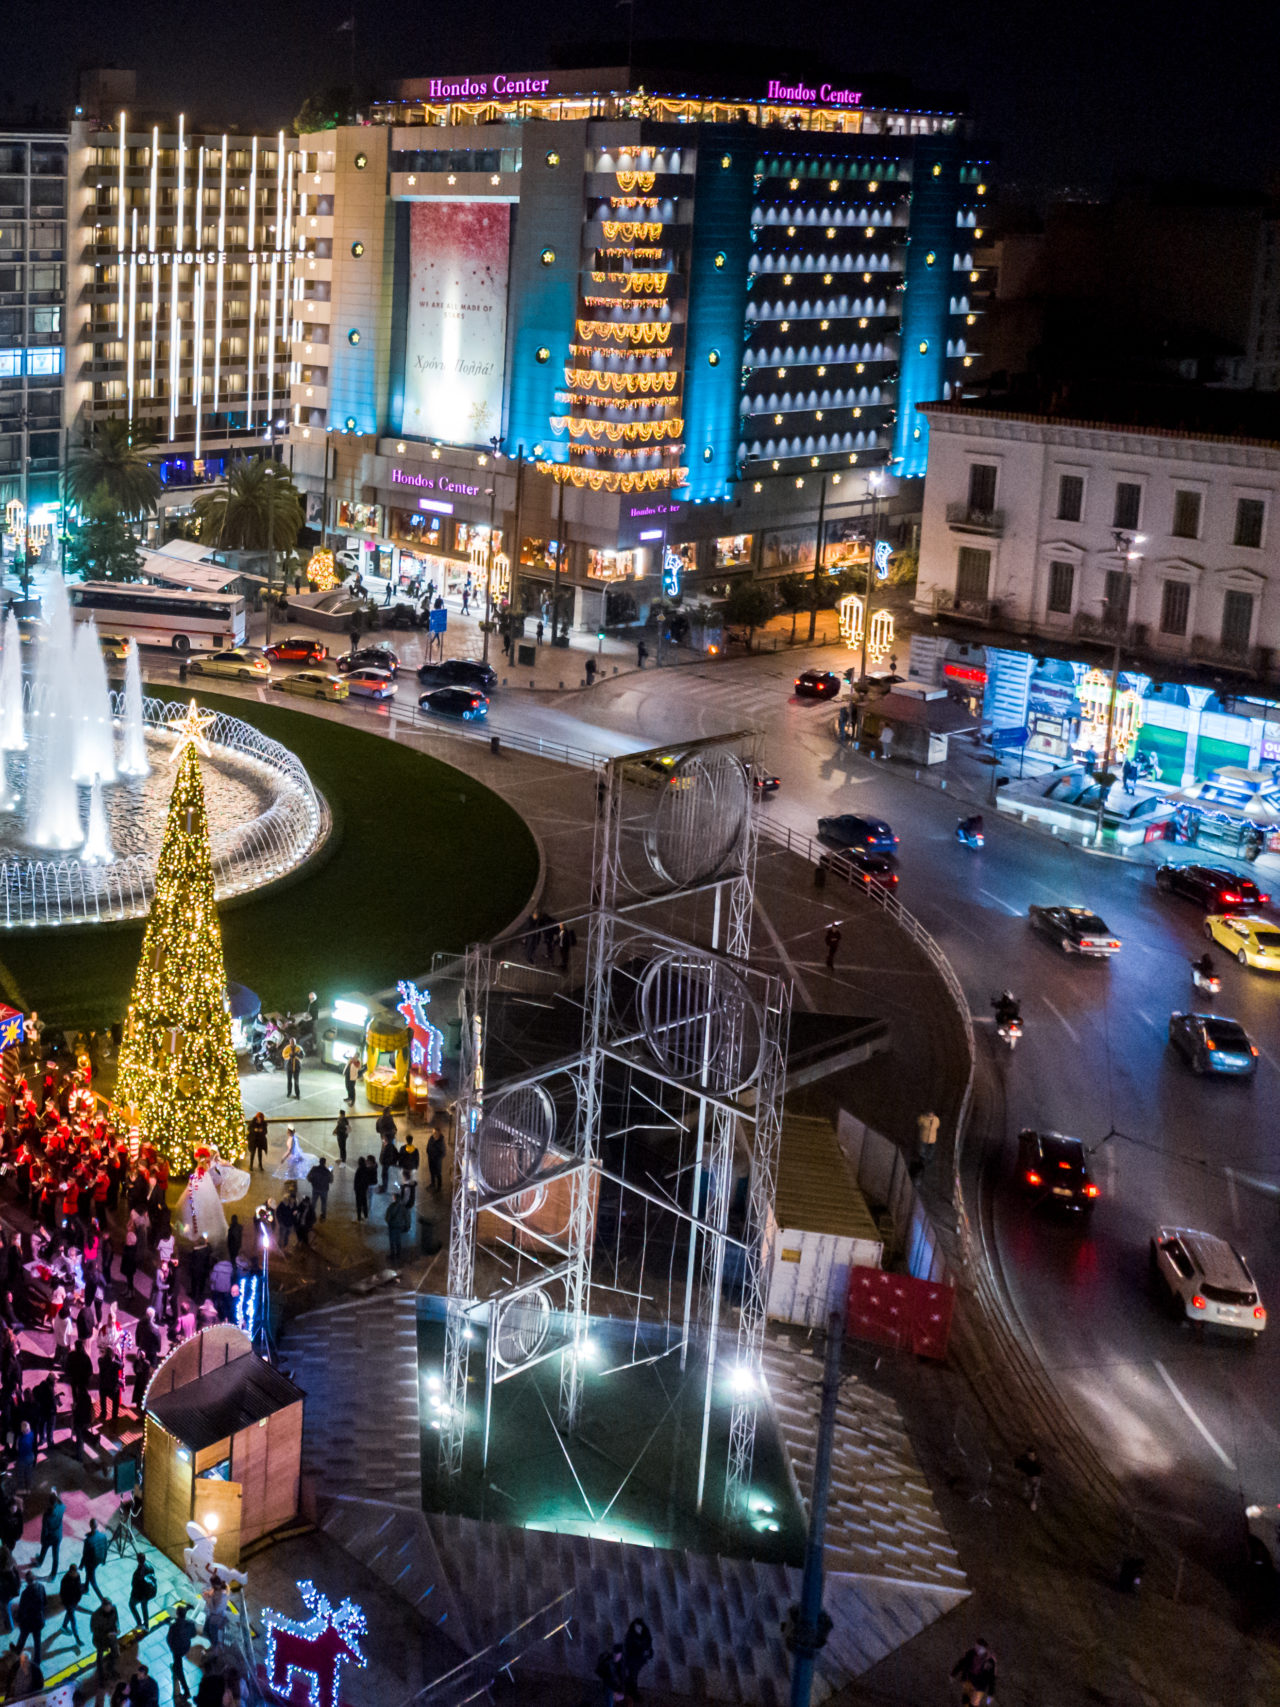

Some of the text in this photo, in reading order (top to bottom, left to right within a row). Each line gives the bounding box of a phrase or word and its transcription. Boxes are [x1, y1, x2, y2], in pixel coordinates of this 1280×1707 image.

[429, 75, 550, 97] Hondos Center
[768, 80, 863, 104] Hondos Center
[118, 252, 227, 265] LIGHTHOUSE
[461, 304, 481, 312] MADE
[414, 354, 448, 374] Χρόνι
[392, 469, 480, 496] Hondos Center
[657, 504, 681, 513] Ceter
